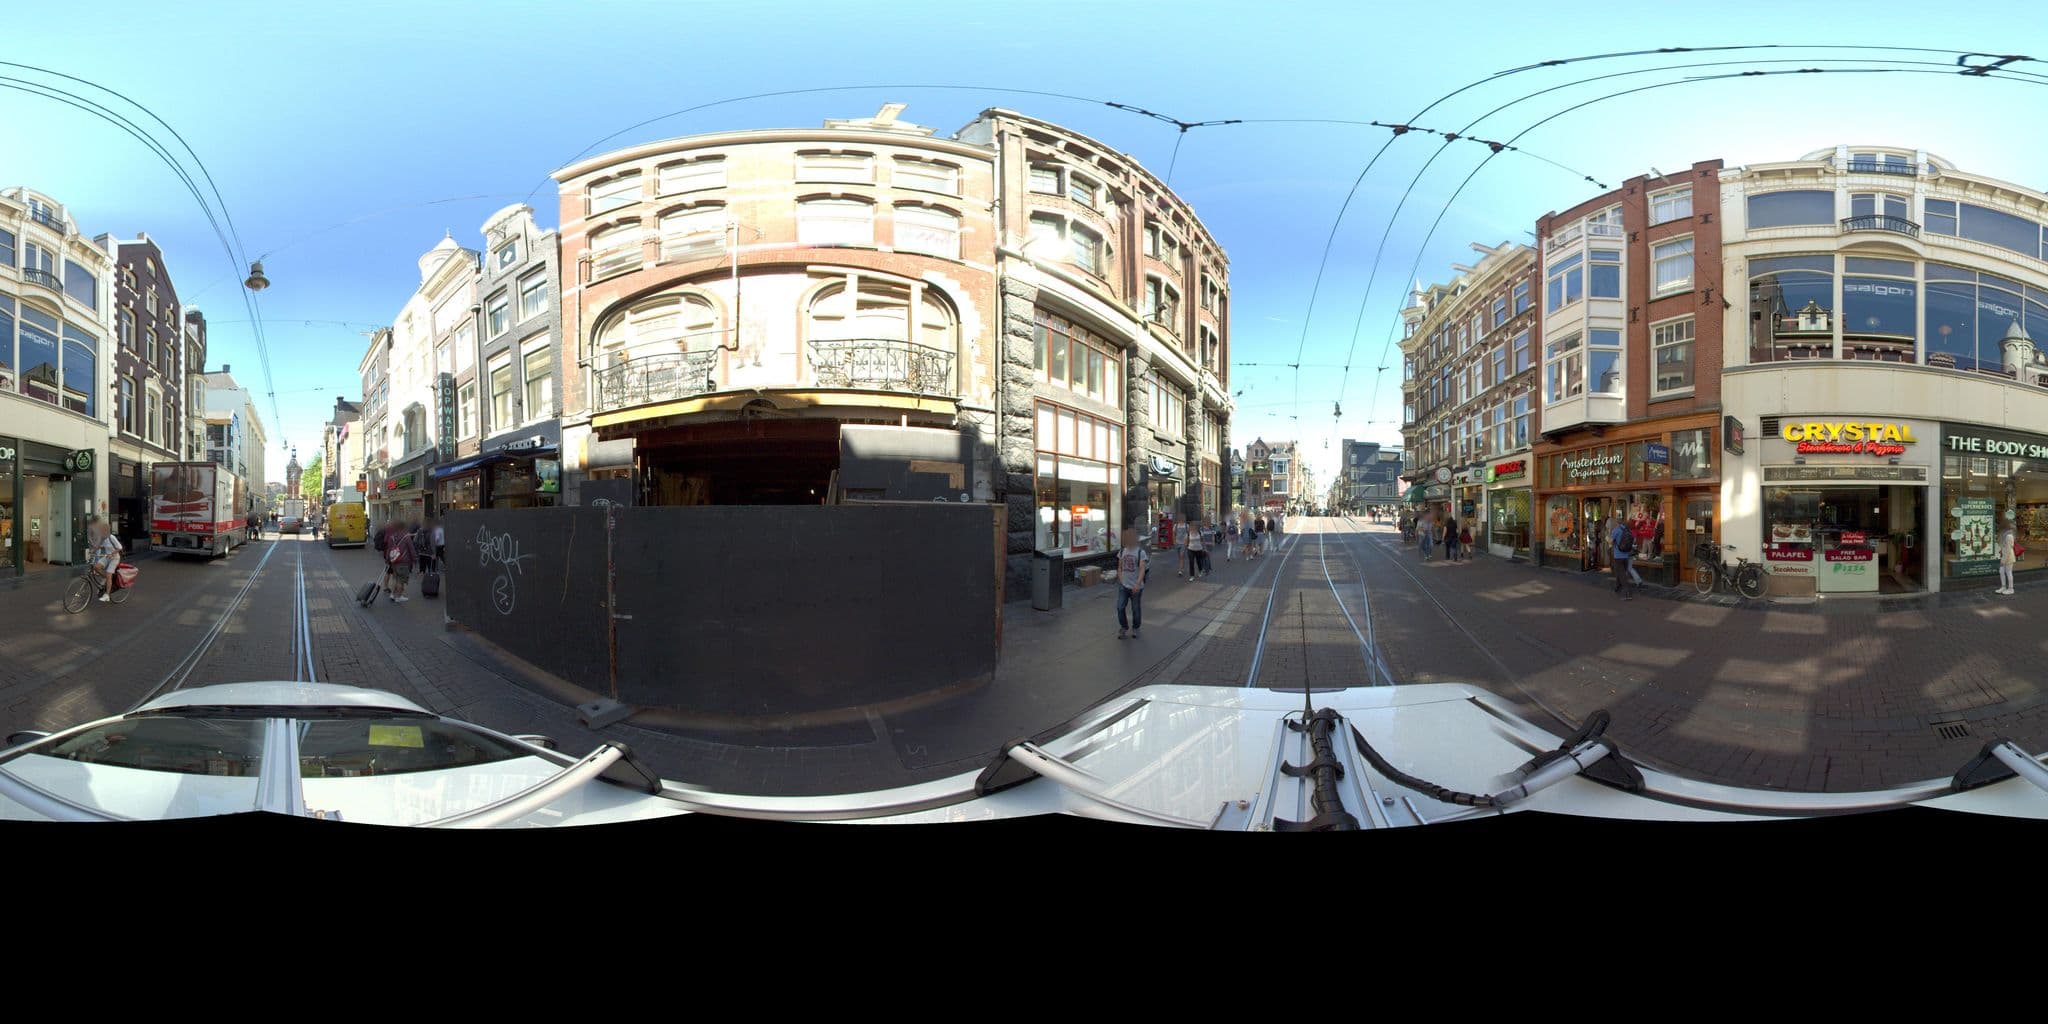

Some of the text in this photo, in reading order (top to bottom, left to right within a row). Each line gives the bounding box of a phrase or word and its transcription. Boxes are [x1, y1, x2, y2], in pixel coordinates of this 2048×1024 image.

[1844, 284, 1914, 296] saigon
[1978, 302, 2019, 318] saigon
[443, 379, 453, 455] TOPWATCH
[1783, 422, 1918, 443] CRYSTAL
[1797, 442, 1905, 456] Steakhouse & Pizzeria
[1948, 436, 2048, 459] THE BODY SH
[1560, 453, 1623, 471] Amsterdam
[1570, 468, 1610, 479] Originals
[1773, 565, 1809, 574] Steakhouse
